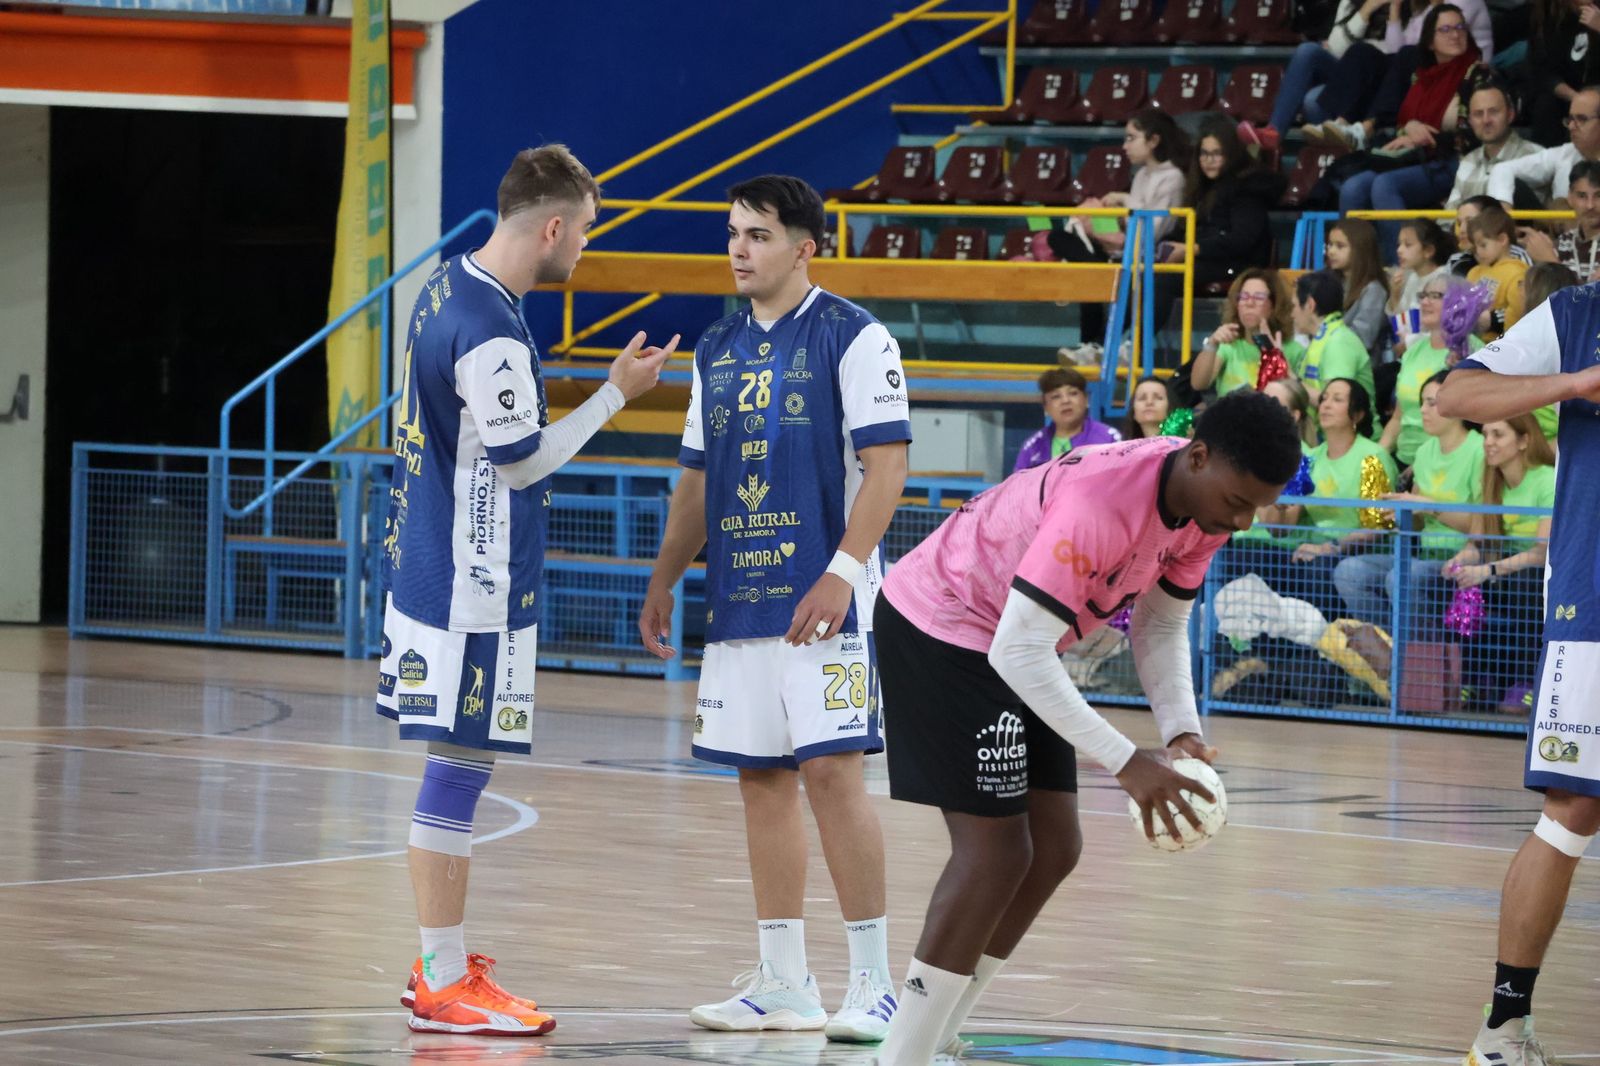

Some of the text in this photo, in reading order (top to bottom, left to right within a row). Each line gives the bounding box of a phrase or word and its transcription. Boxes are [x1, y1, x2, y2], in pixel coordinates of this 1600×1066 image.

[1181, 73, 1199, 89] 74
[969, 152, 986, 168] 76
[1037, 152, 1056, 169] 74
[1105, 153, 1122, 169] 72
[886, 233, 904, 249] 74
[782, 370, 813, 380] ZAMORA
[738, 369, 774, 412] 28
[469, 457, 479, 500] Eléctricos
[476, 482, 490, 555] PIORNO,
[721, 511, 801, 531] CJA RURAL
[744, 529, 776, 538] ZAMORA
[732, 550, 782, 569] ZAMORA
[766, 584, 793, 595] Senda
[822, 662, 867, 710] 28
